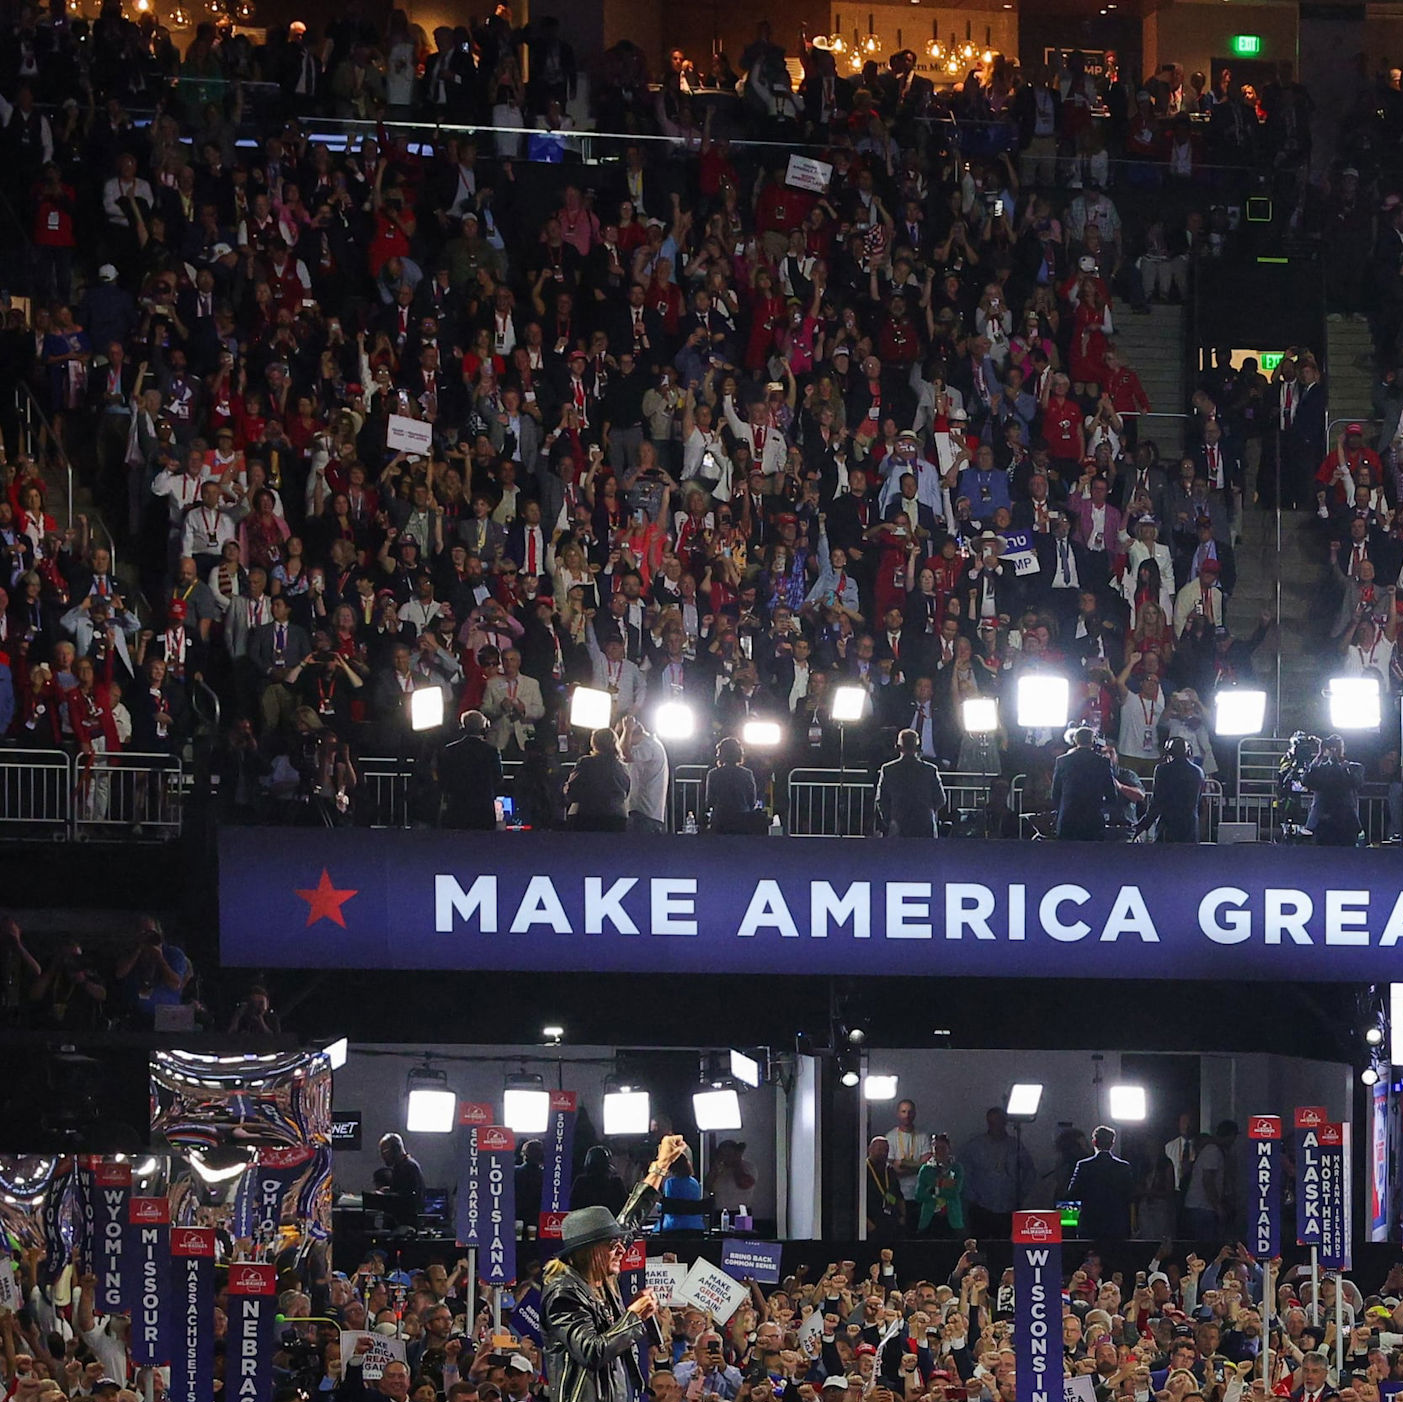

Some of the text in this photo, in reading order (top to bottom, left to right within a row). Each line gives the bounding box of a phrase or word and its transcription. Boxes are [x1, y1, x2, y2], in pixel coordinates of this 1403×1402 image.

[1238, 36, 1257, 52] EXIT
[436, 874, 698, 936] MAKE
[737, 880, 1160, 942] AMERICA
[555, 1113, 564, 1152] SOUTH
[468, 1181, 479, 1239] DAKOTA
[1257, 1142, 1272, 1253] MARYLAND
[1302, 1131, 1320, 1235] ALASKA
[1321, 1154, 1332, 1257] NORTHERN
[1333, 1155, 1342, 1258] MARIANA ISLANDS
[489, 1155, 505, 1278] LOUISIANA
[104, 1190, 125, 1305] WYOMING
[724, 1258, 777, 1271] COMMON SENSE
[729, 1252, 773, 1263] BRING BACK
[141, 1228, 160, 1358] MISSOURI
[693, 1291, 721, 1314] AGAIN!
[698, 1276, 732, 1304] AMERICA
[698, 1286, 724, 1306] GREAT
[709, 1273, 732, 1292] MAKE
